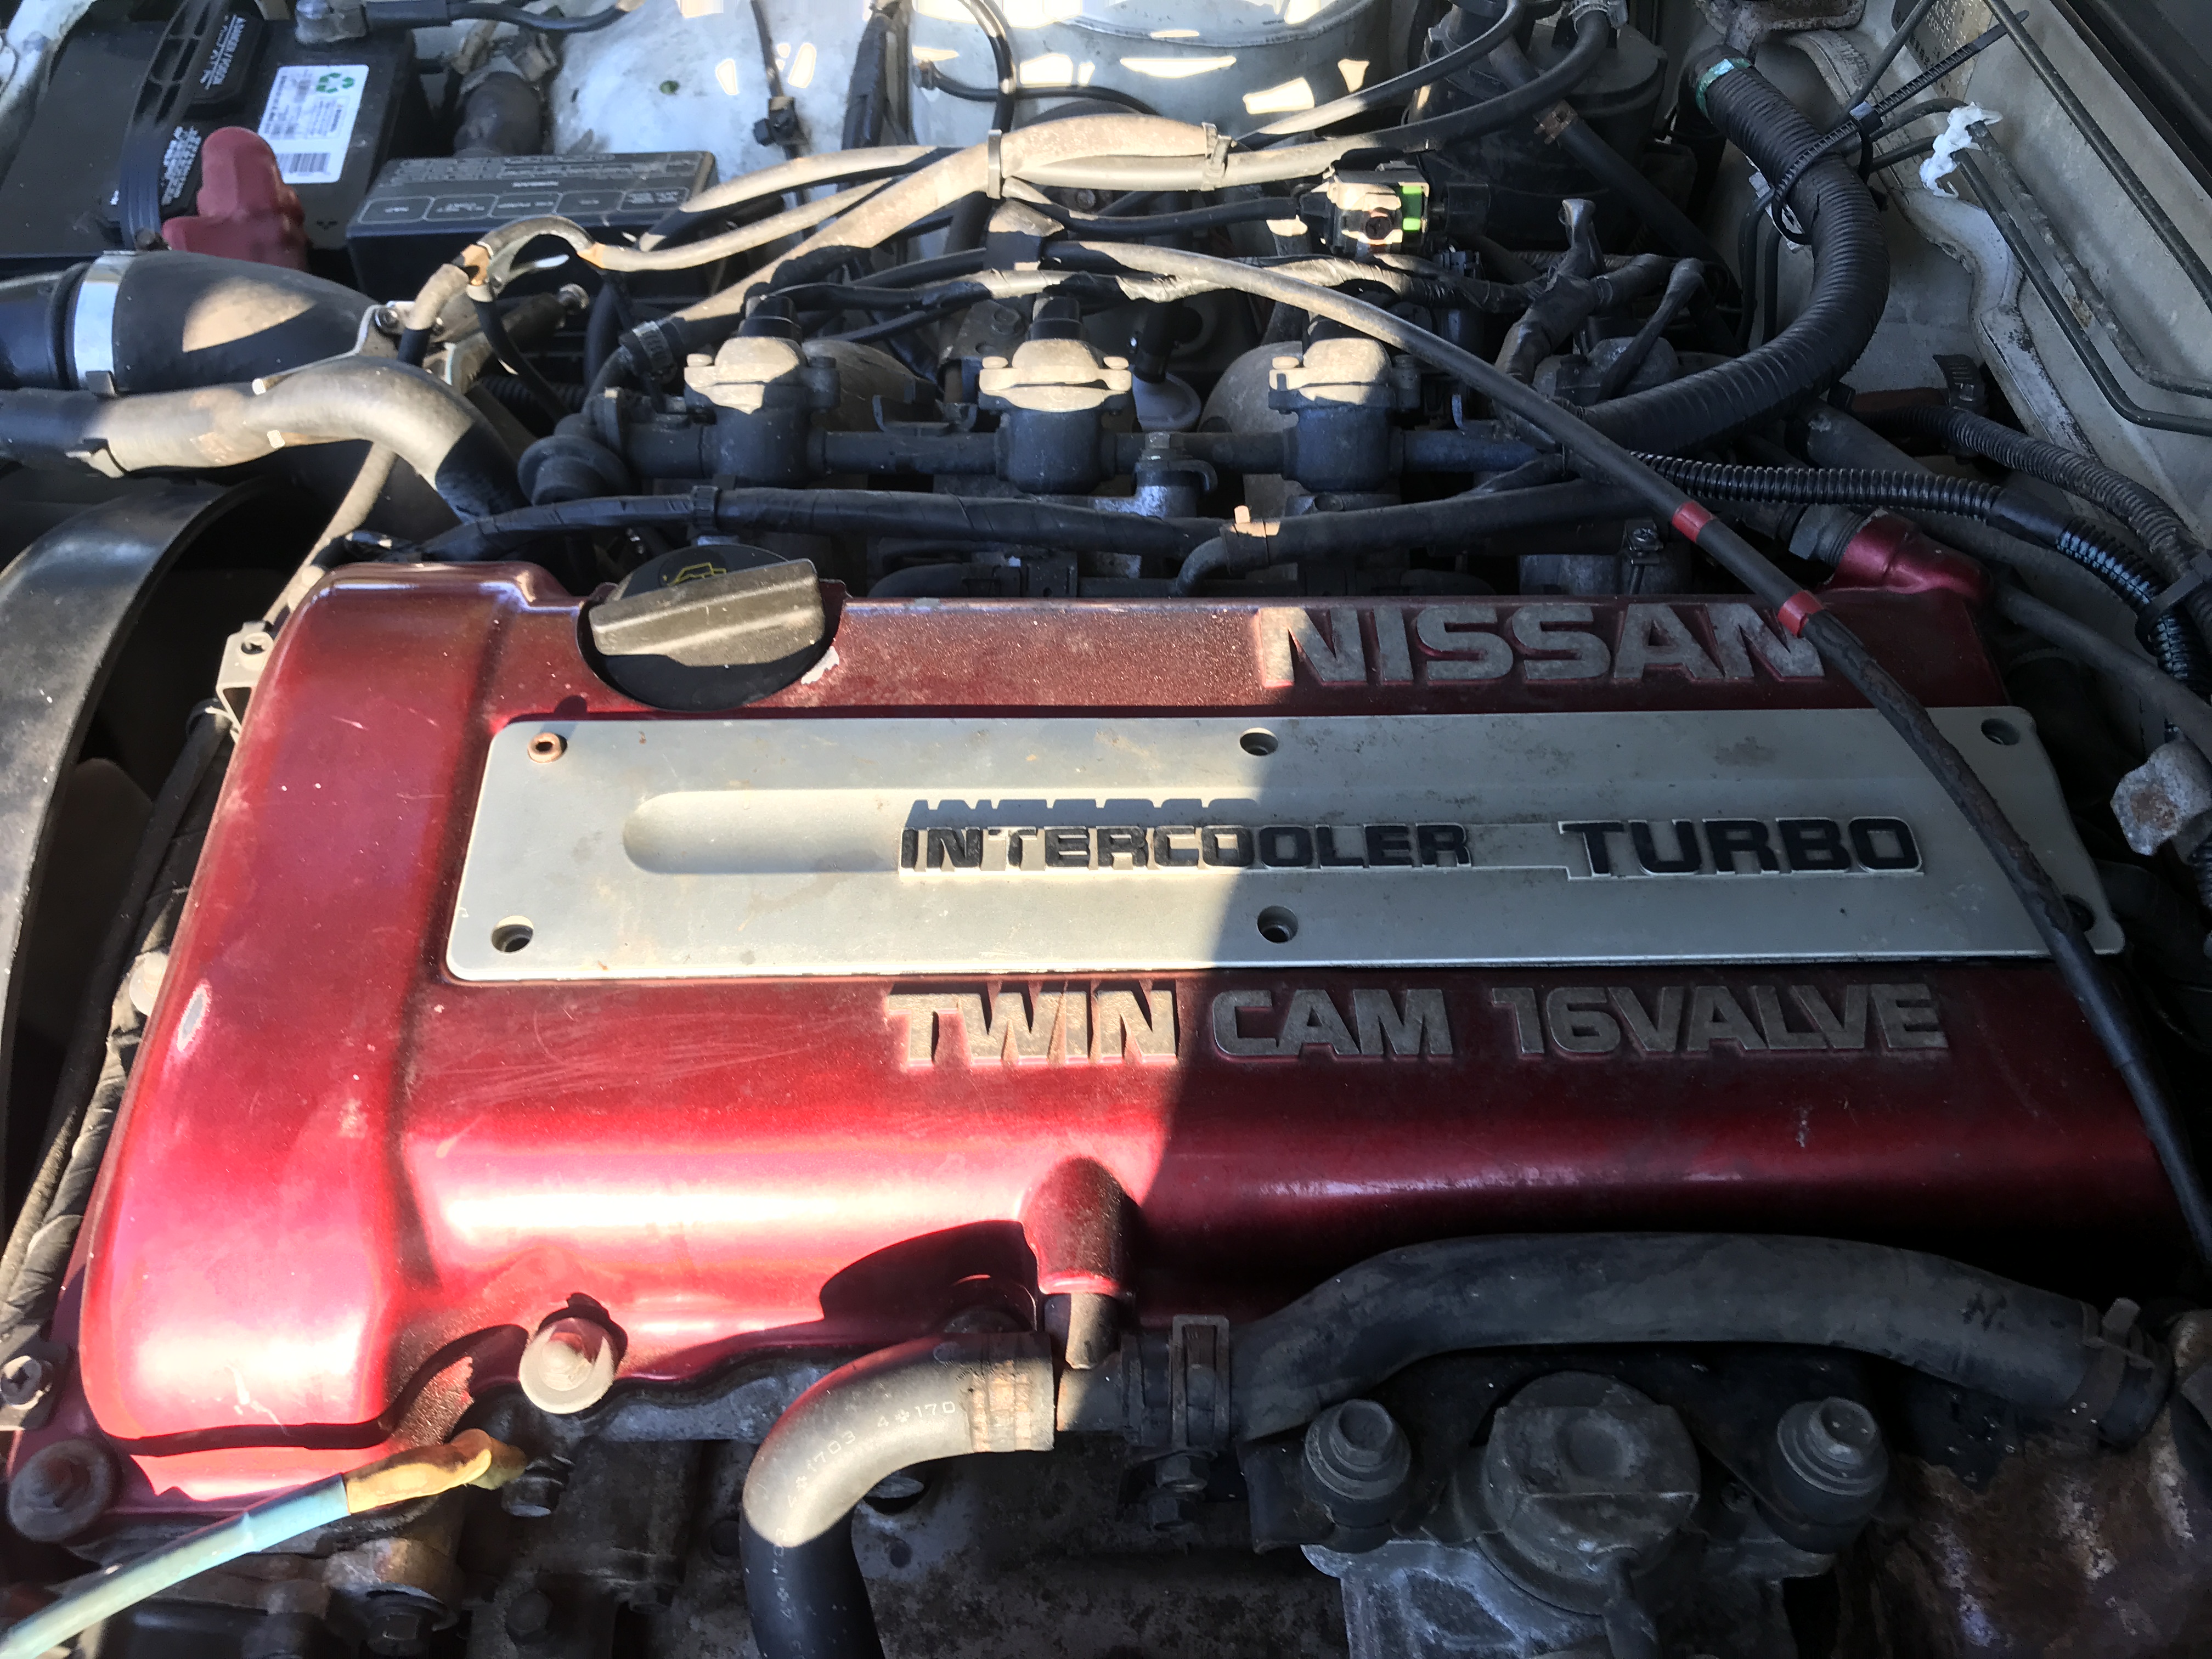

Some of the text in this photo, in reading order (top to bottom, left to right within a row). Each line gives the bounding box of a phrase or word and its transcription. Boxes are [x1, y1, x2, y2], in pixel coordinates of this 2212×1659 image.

[1258, 601, 1825, 686] NISSAN
[899, 816, 1923, 877] INTERCOOLER TURBO
[887, 983, 1949, 1065] TWIN CAM 16VALVE
